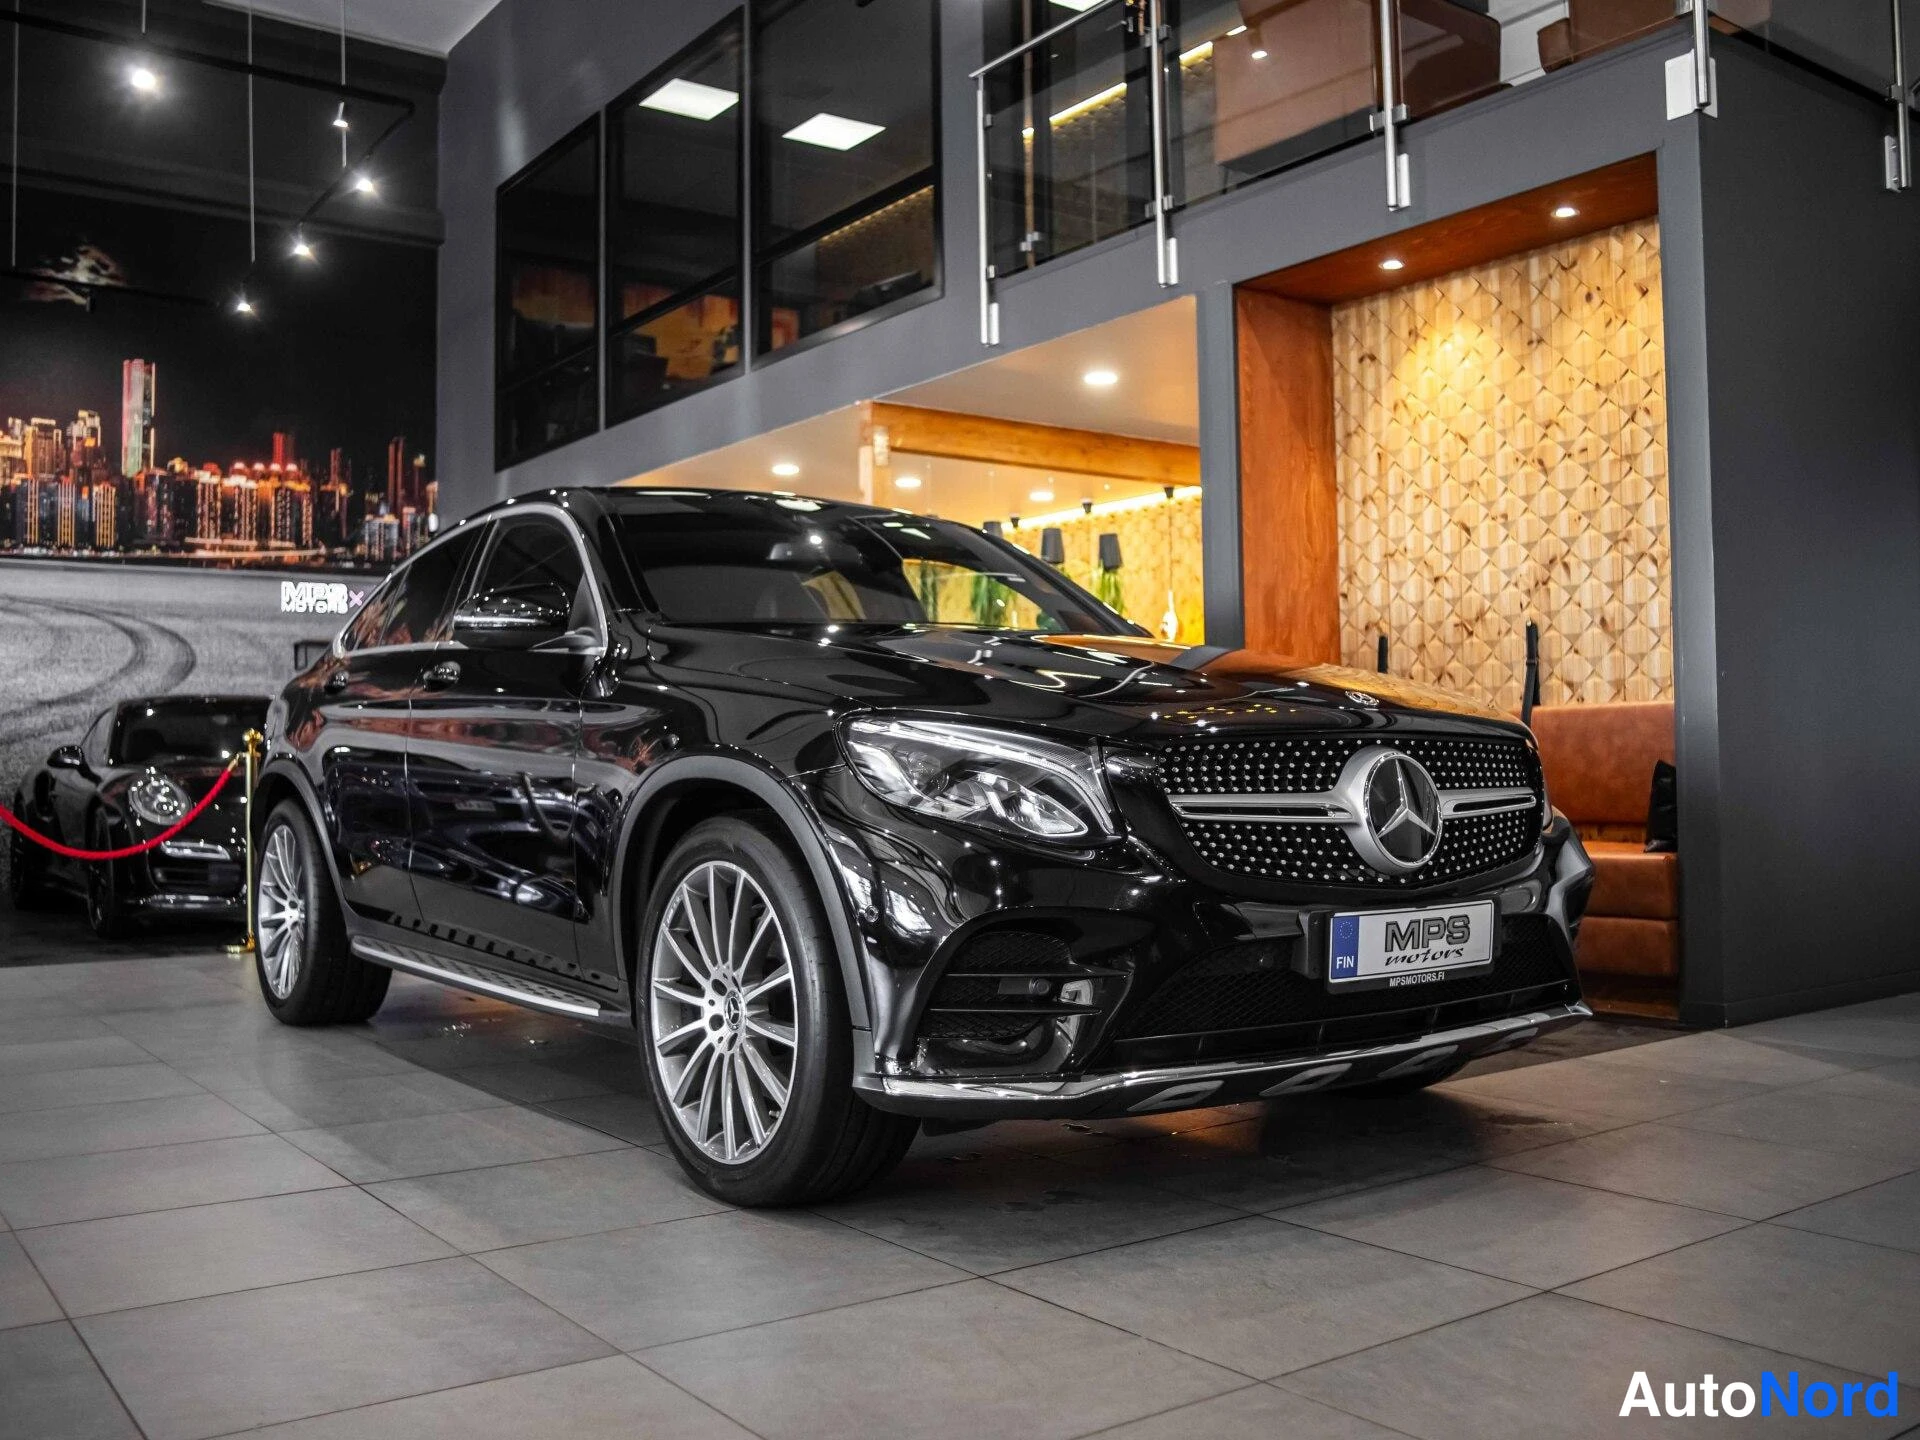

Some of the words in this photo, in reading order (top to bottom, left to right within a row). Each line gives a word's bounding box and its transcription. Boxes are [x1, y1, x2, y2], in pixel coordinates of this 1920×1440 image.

[1384, 914, 1470, 952] MPS
[1336, 955, 1354, 969] FIN
[1385, 947, 1464, 967] motors
[1389, 971, 1445, 987] MPSMOTORS.FI
